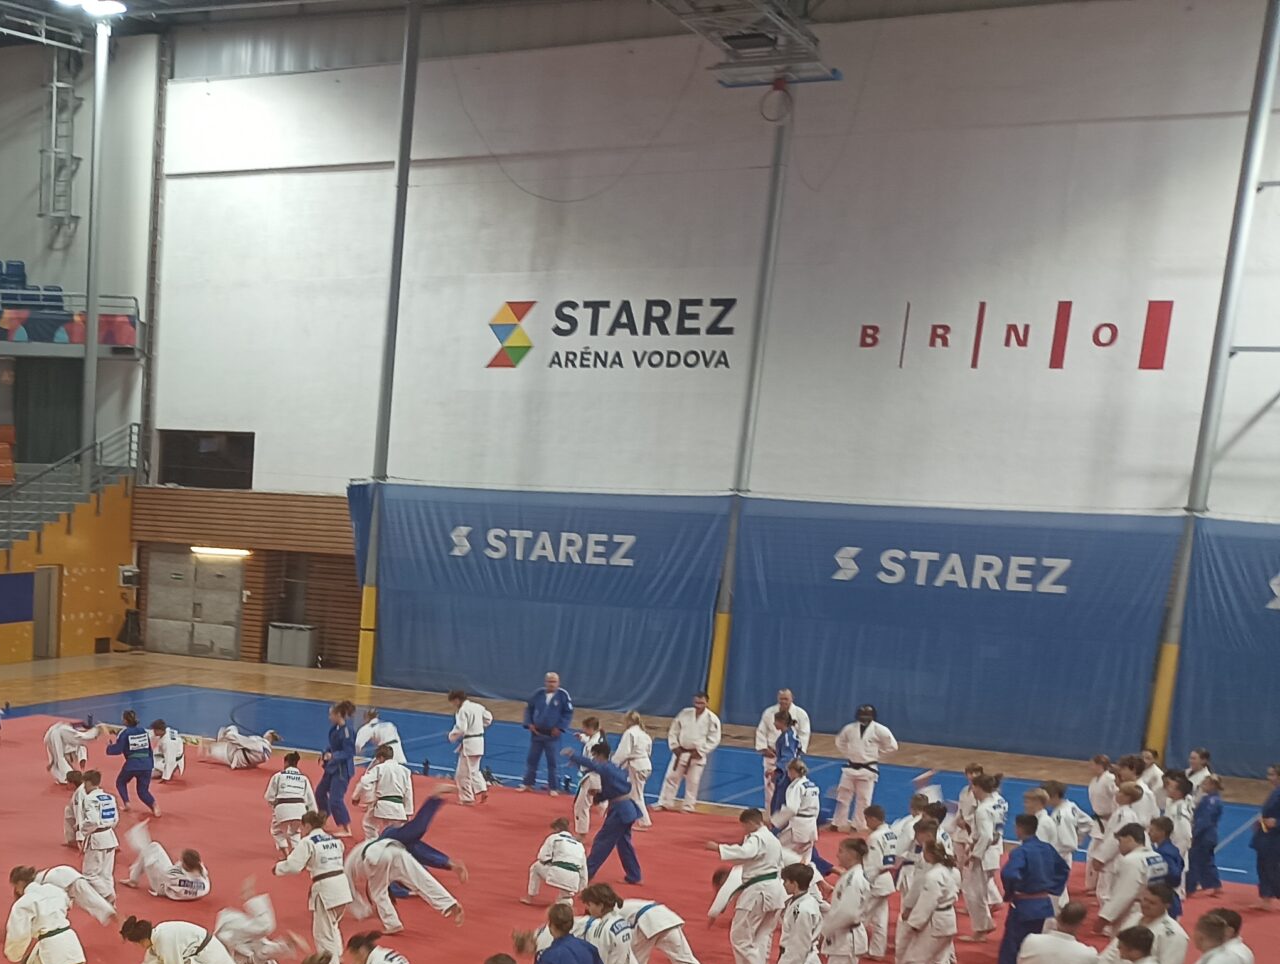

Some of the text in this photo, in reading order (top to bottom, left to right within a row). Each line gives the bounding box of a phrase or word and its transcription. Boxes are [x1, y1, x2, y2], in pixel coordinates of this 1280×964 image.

[551, 298, 737, 336] STAREZ
[549, 346, 730, 368] ARÉNA VODOVA
[484, 528, 636, 567] STAREZ
[876, 549, 1072, 594] STAREZ
